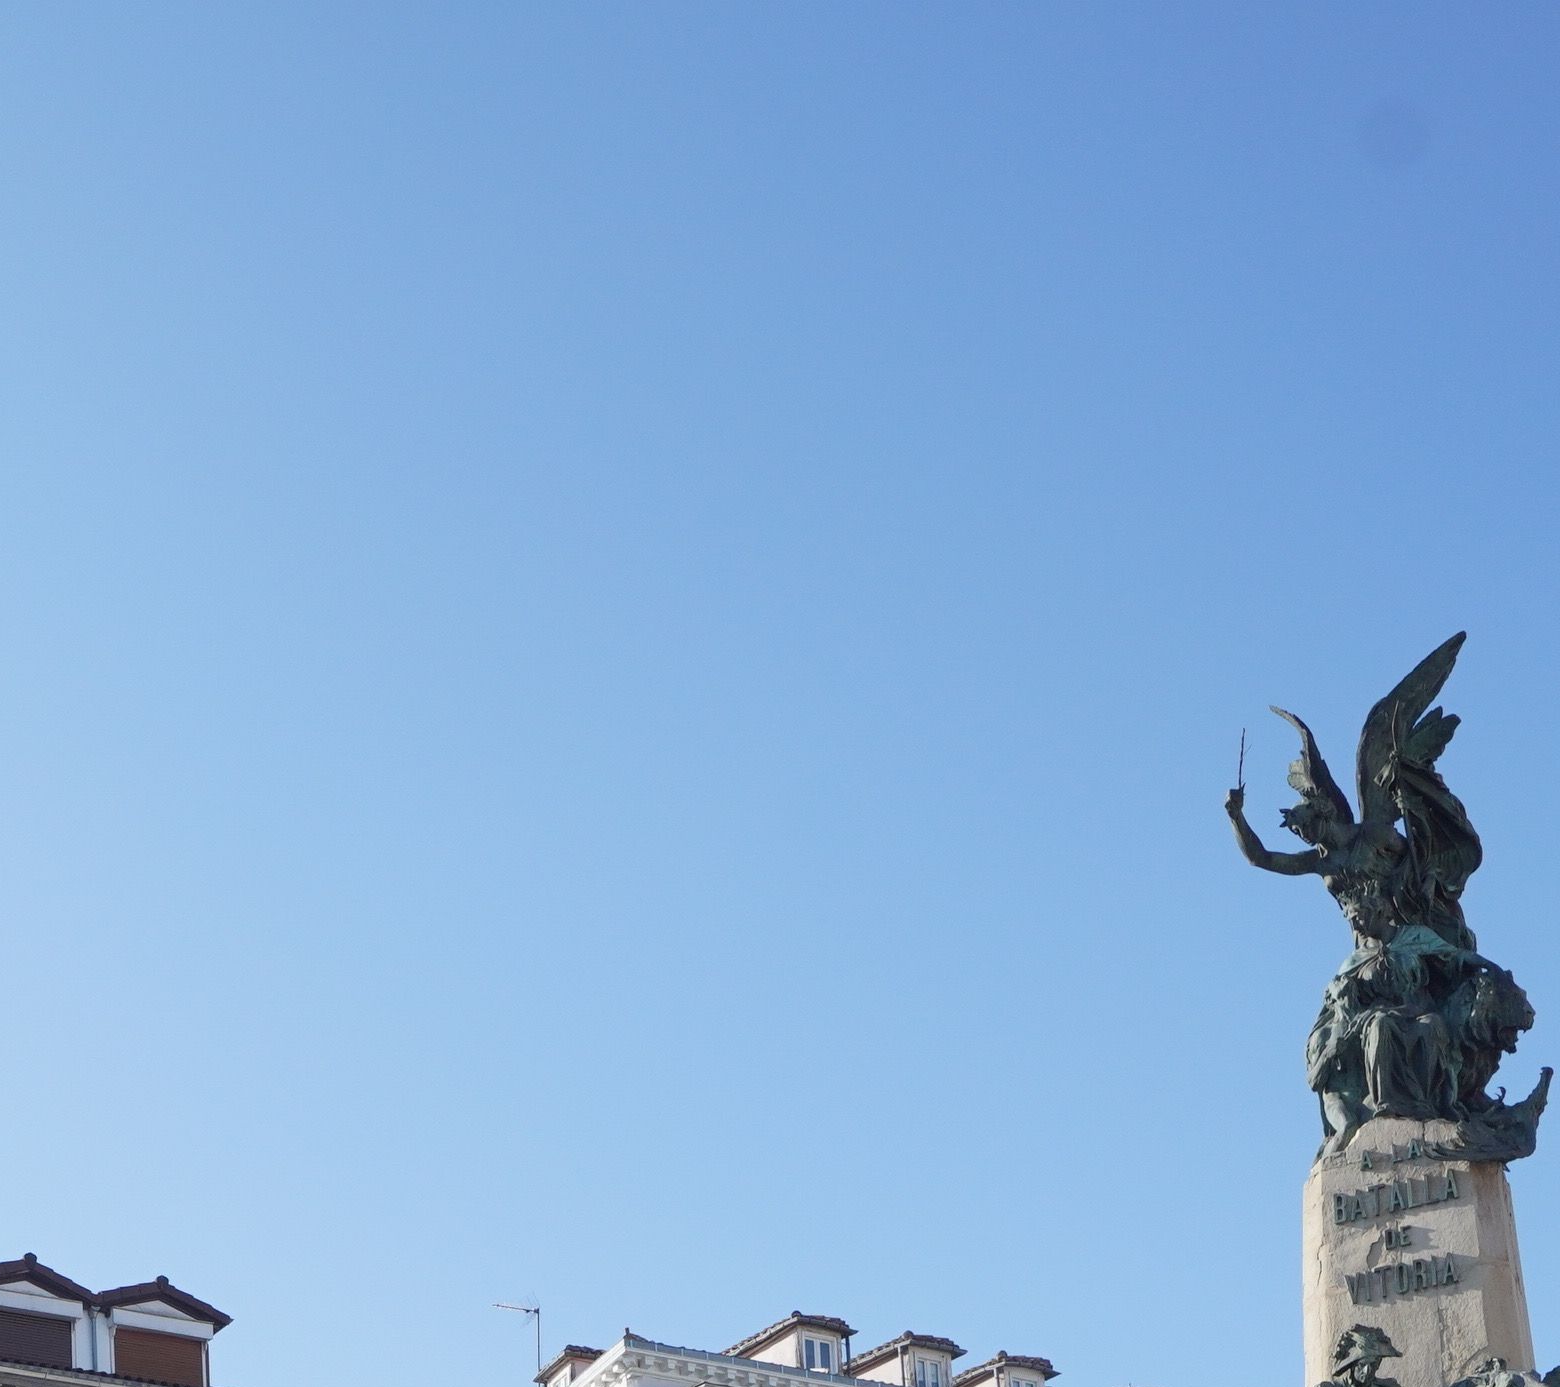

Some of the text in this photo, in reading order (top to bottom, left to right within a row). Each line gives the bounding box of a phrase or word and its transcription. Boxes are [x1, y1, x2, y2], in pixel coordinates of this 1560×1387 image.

[1392, 1138, 1421, 1164] LA
[1334, 1169, 1458, 1225] BATALLA
[1382, 1225, 1412, 1250] DE
[1344, 1252, 1459, 1304] VITORIA
